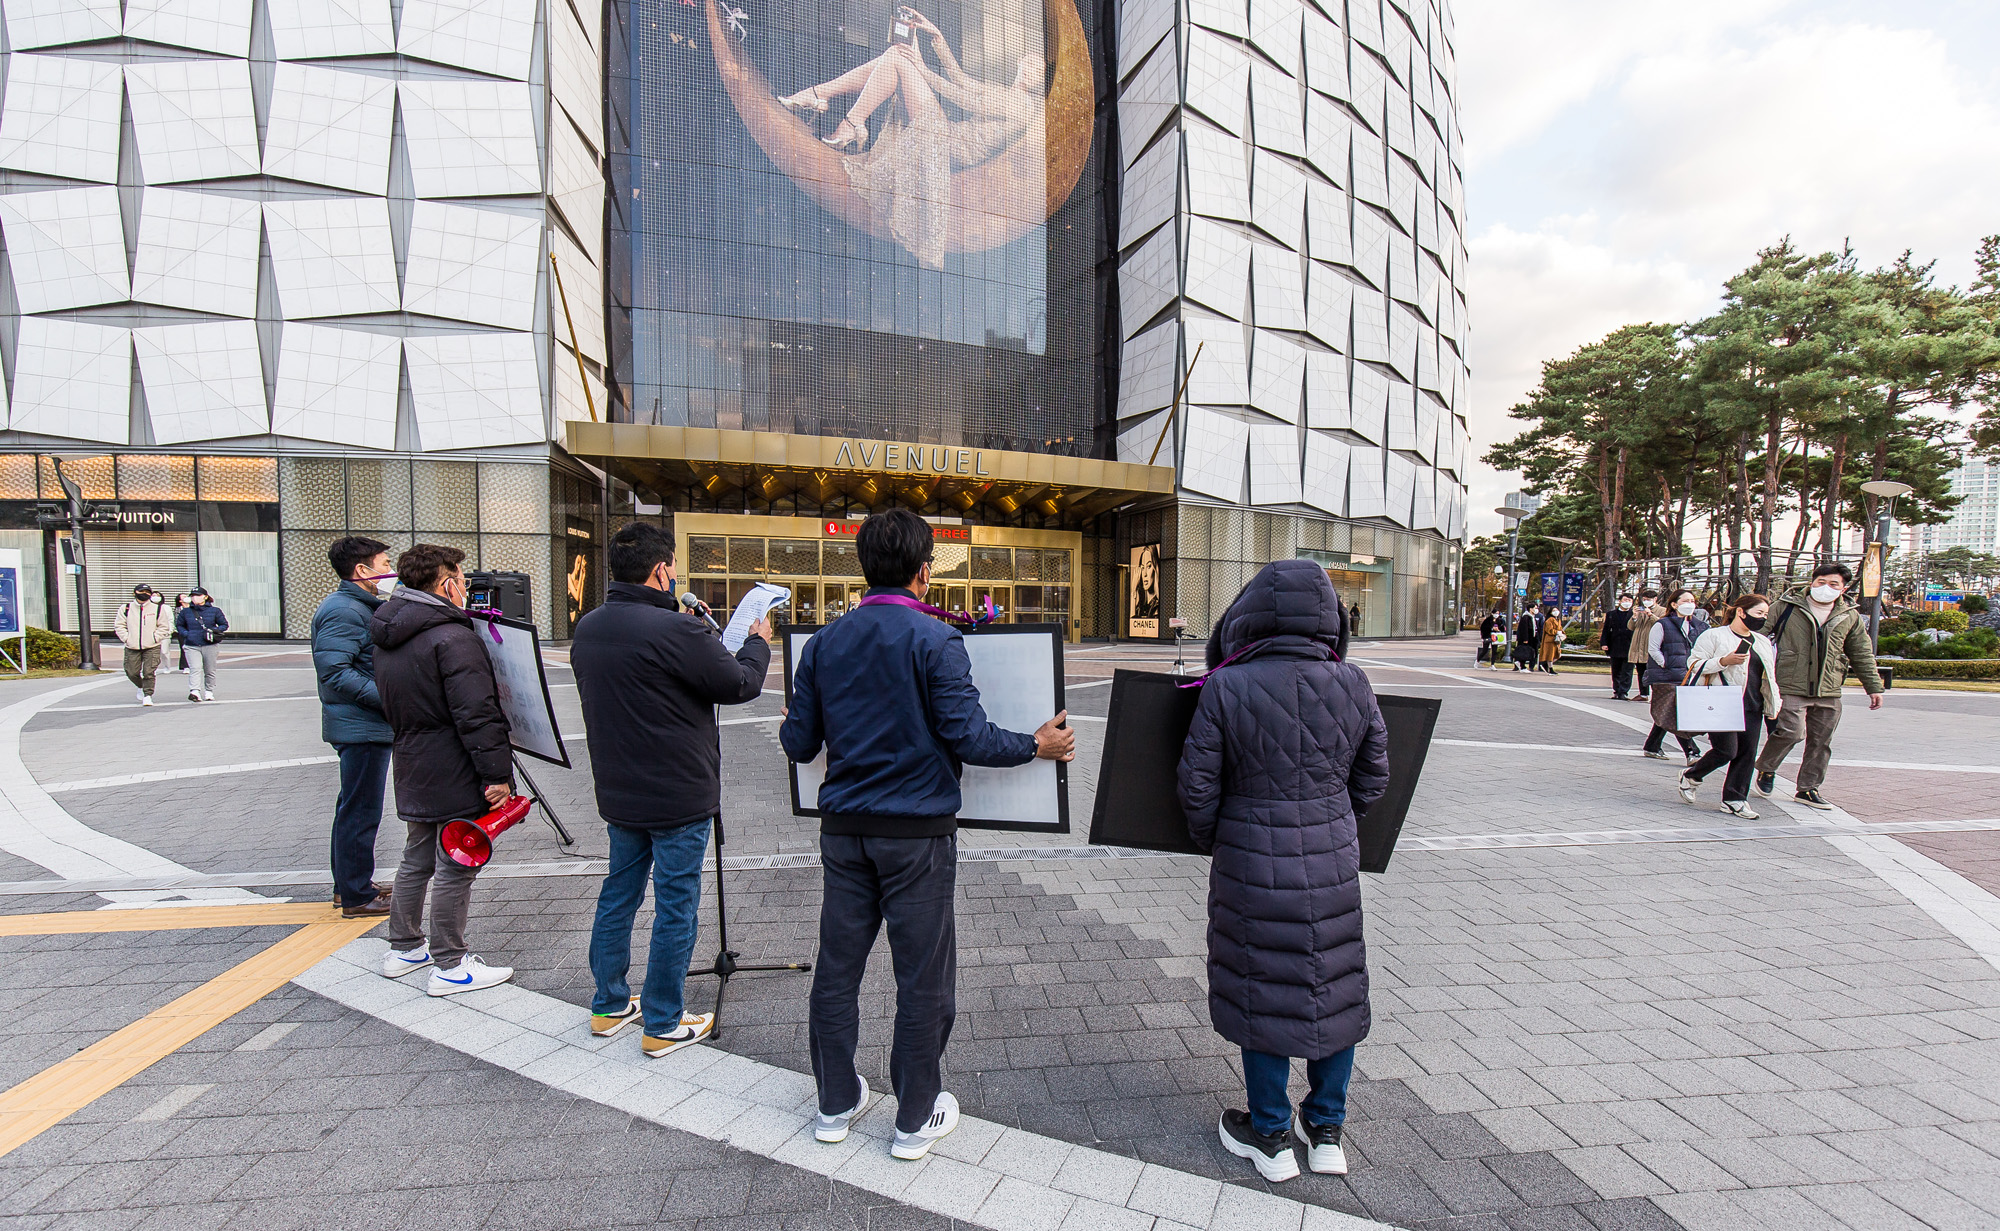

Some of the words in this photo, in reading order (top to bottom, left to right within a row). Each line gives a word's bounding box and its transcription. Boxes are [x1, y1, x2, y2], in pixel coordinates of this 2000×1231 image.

[835, 441, 989, 475] AVENUEL
[113, 512, 174, 523] VUITTON
[933, 528, 969, 540] FREE
[1133, 620, 1155, 629] CHANEL
